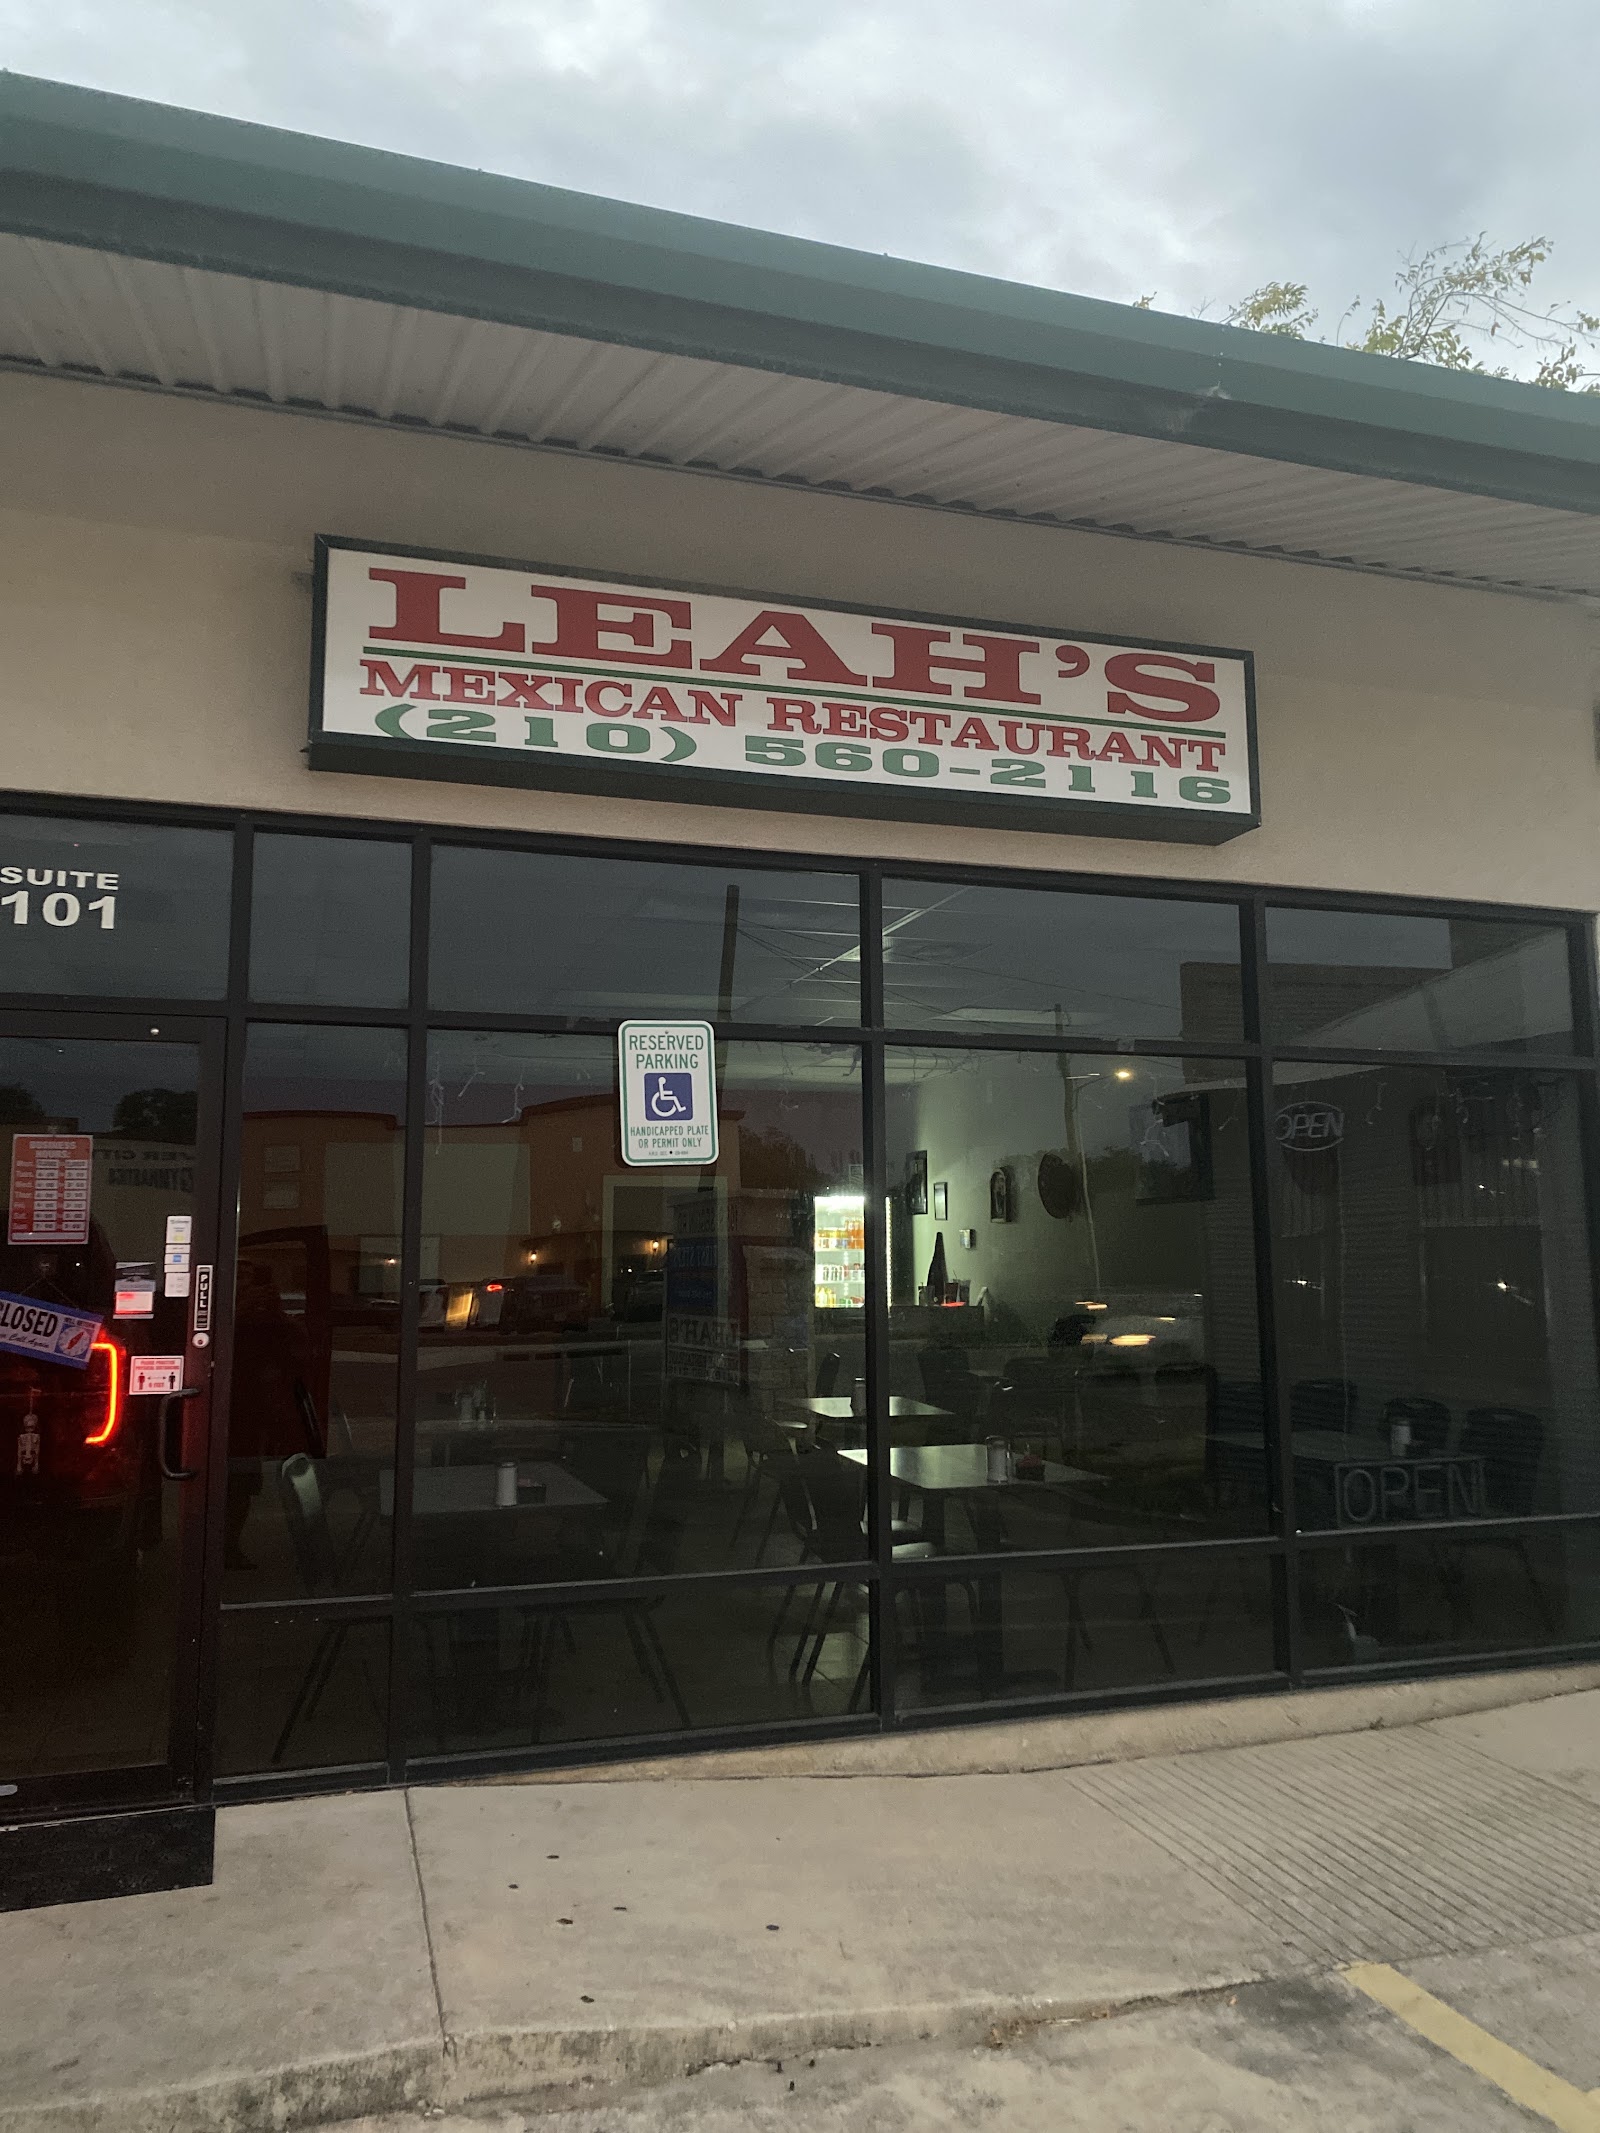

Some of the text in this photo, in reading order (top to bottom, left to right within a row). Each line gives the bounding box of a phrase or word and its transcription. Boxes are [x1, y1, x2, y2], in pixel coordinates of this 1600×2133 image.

[369, 567, 1220, 722] LEAH'S
[360, 659, 1226, 772] MEXICAN RESTAURANT
[374, 703, 1231, 804] (210) 560-2116
[0, 867, 119, 890] SUITE
[1, 890, 116, 929] 101
[629, 1035, 704, 1050] RESERVED
[636, 1054, 698, 1069] PARKING
[630, 1125, 709, 1137] HANDICAPPED PLATE
[1273, 1111, 1345, 1140] OPEN
[638, 1137, 702, 1149] OR PERMIT ONLY
[199, 1274, 209, 1308] PULL
[0, 1301, 58, 1338] LOSED
[1343, 1462, 1477, 1521] OPEN
